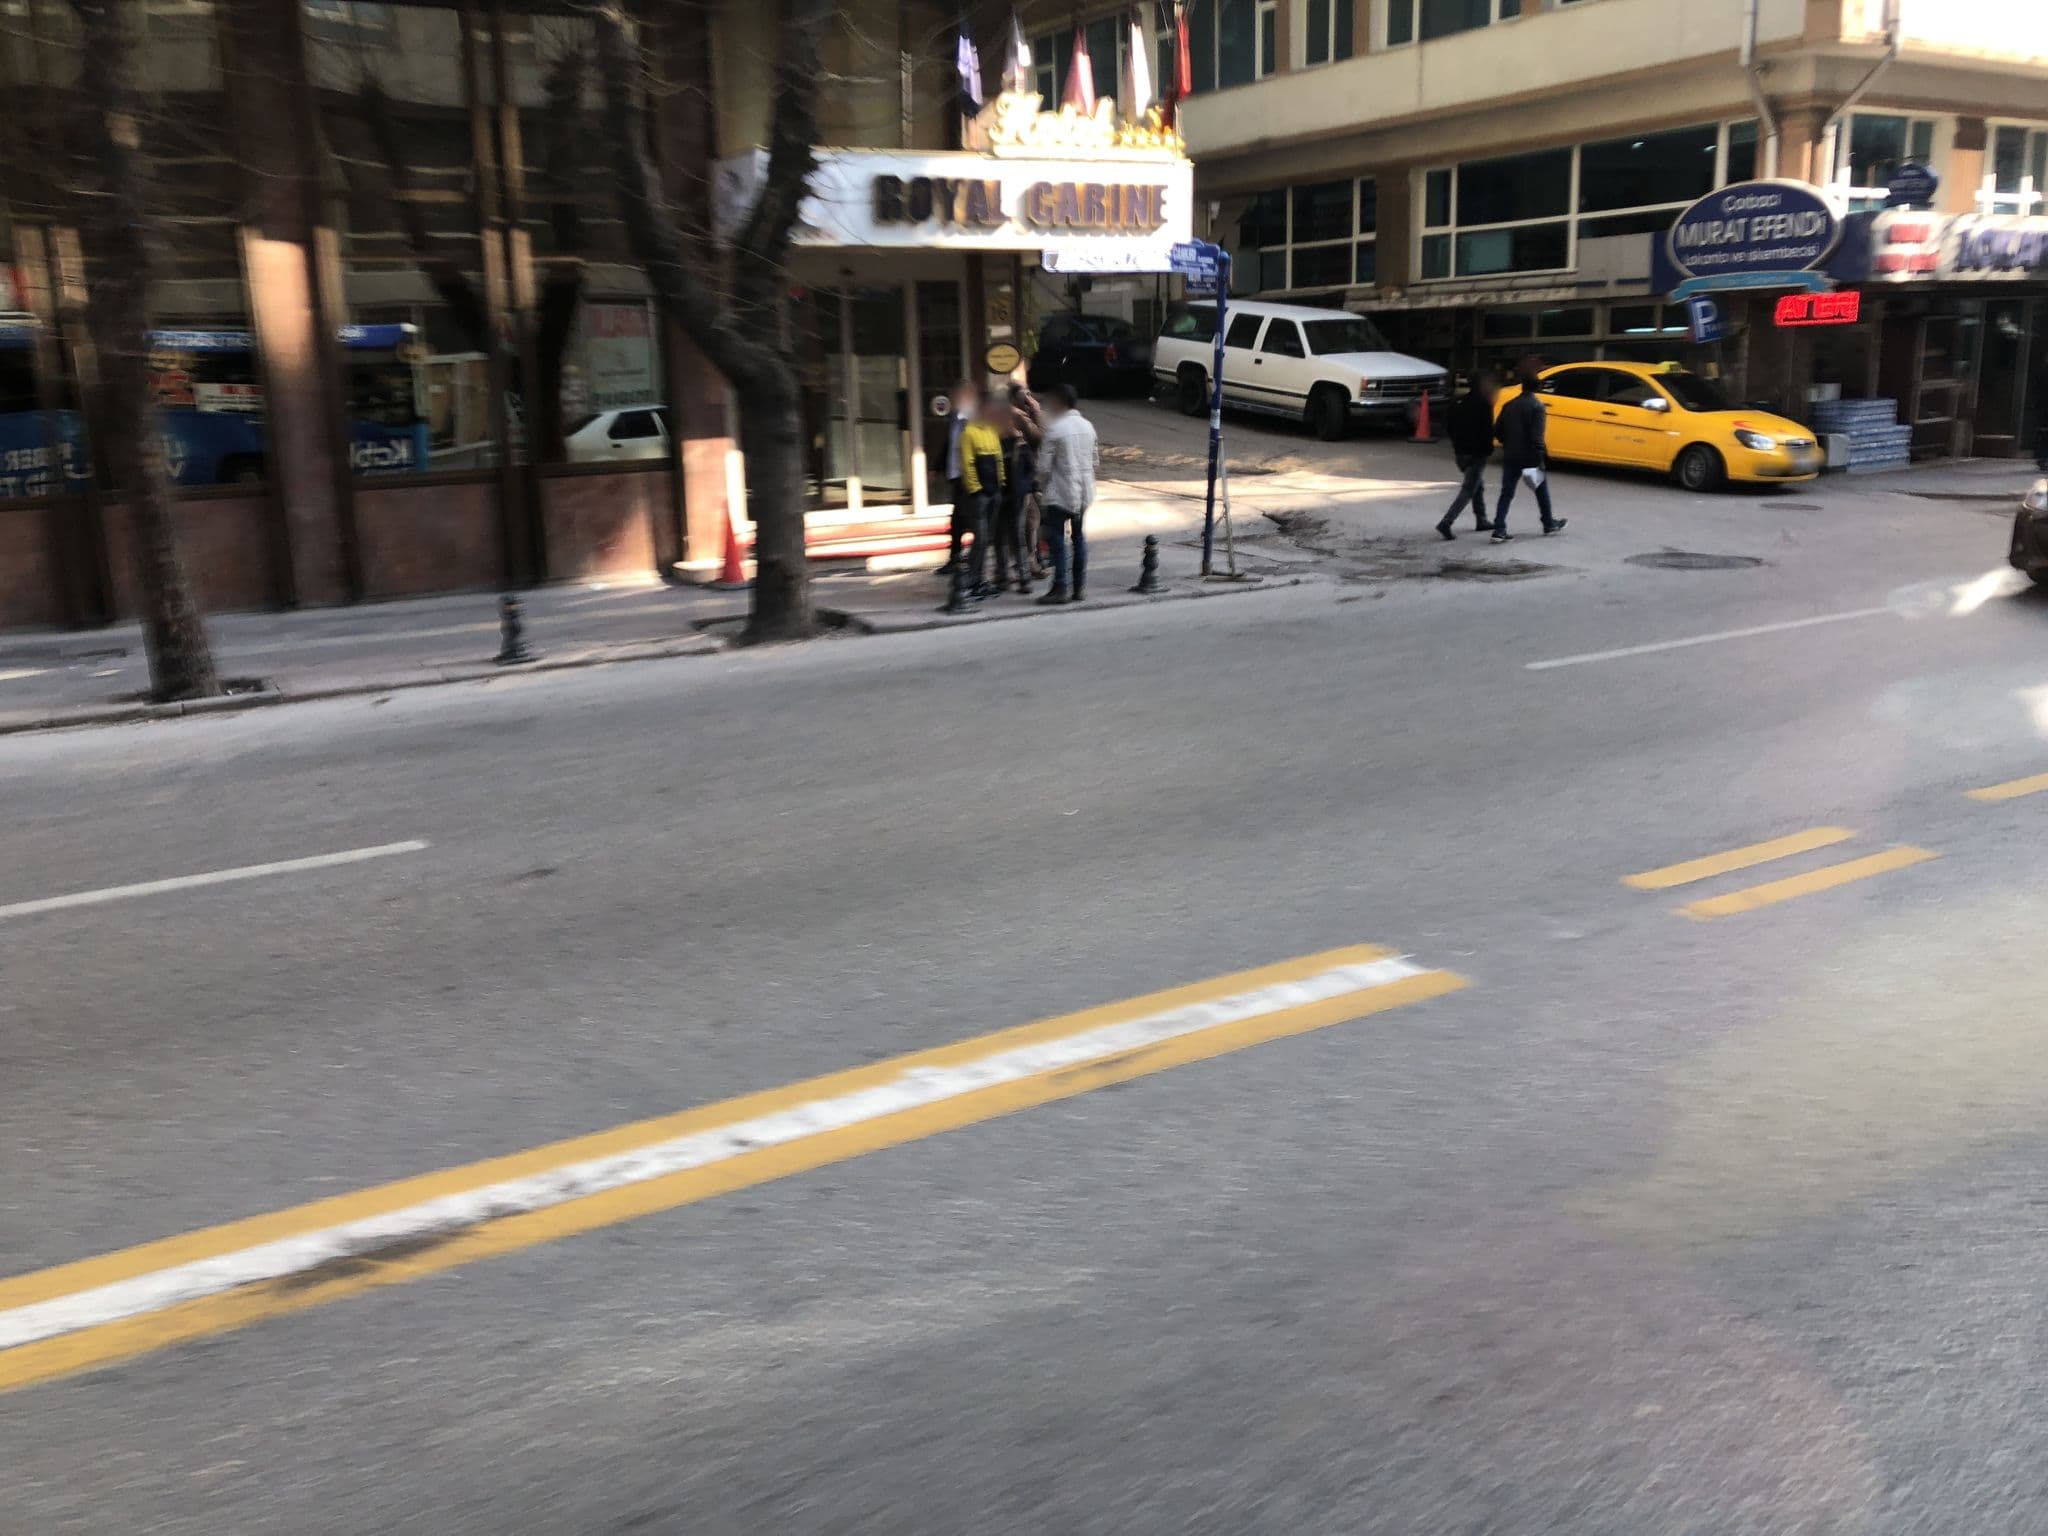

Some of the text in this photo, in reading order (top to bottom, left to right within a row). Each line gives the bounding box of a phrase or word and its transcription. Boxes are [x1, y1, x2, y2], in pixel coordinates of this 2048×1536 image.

[872, 174, 1012, 228] ROYAL
[1679, 217, 1748, 247] MURAT
[1696, 300, 1718, 338] P
